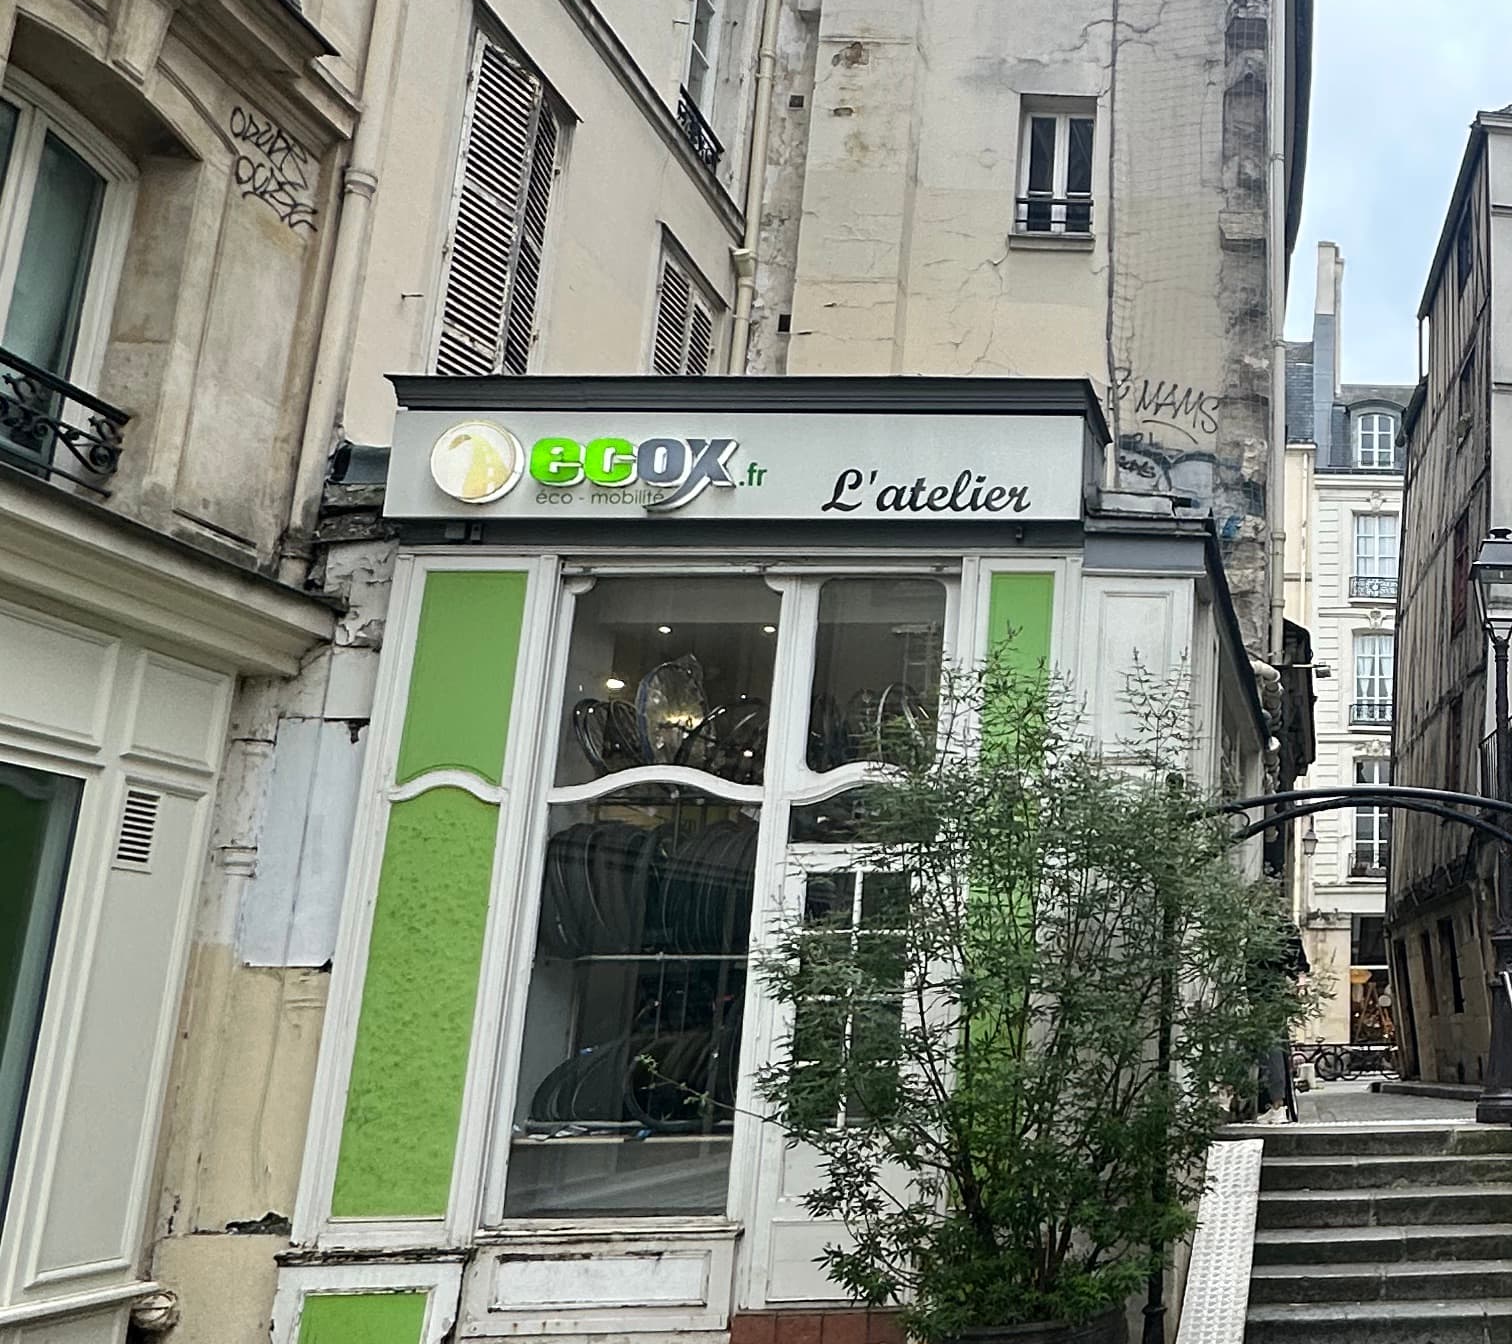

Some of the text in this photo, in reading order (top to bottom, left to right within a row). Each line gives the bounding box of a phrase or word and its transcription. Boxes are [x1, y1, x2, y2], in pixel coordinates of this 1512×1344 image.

[535, 487, 573, 505] éco
[590, 487, 666, 505] mobilité
[821, 468, 1031, 513] L'atelier
